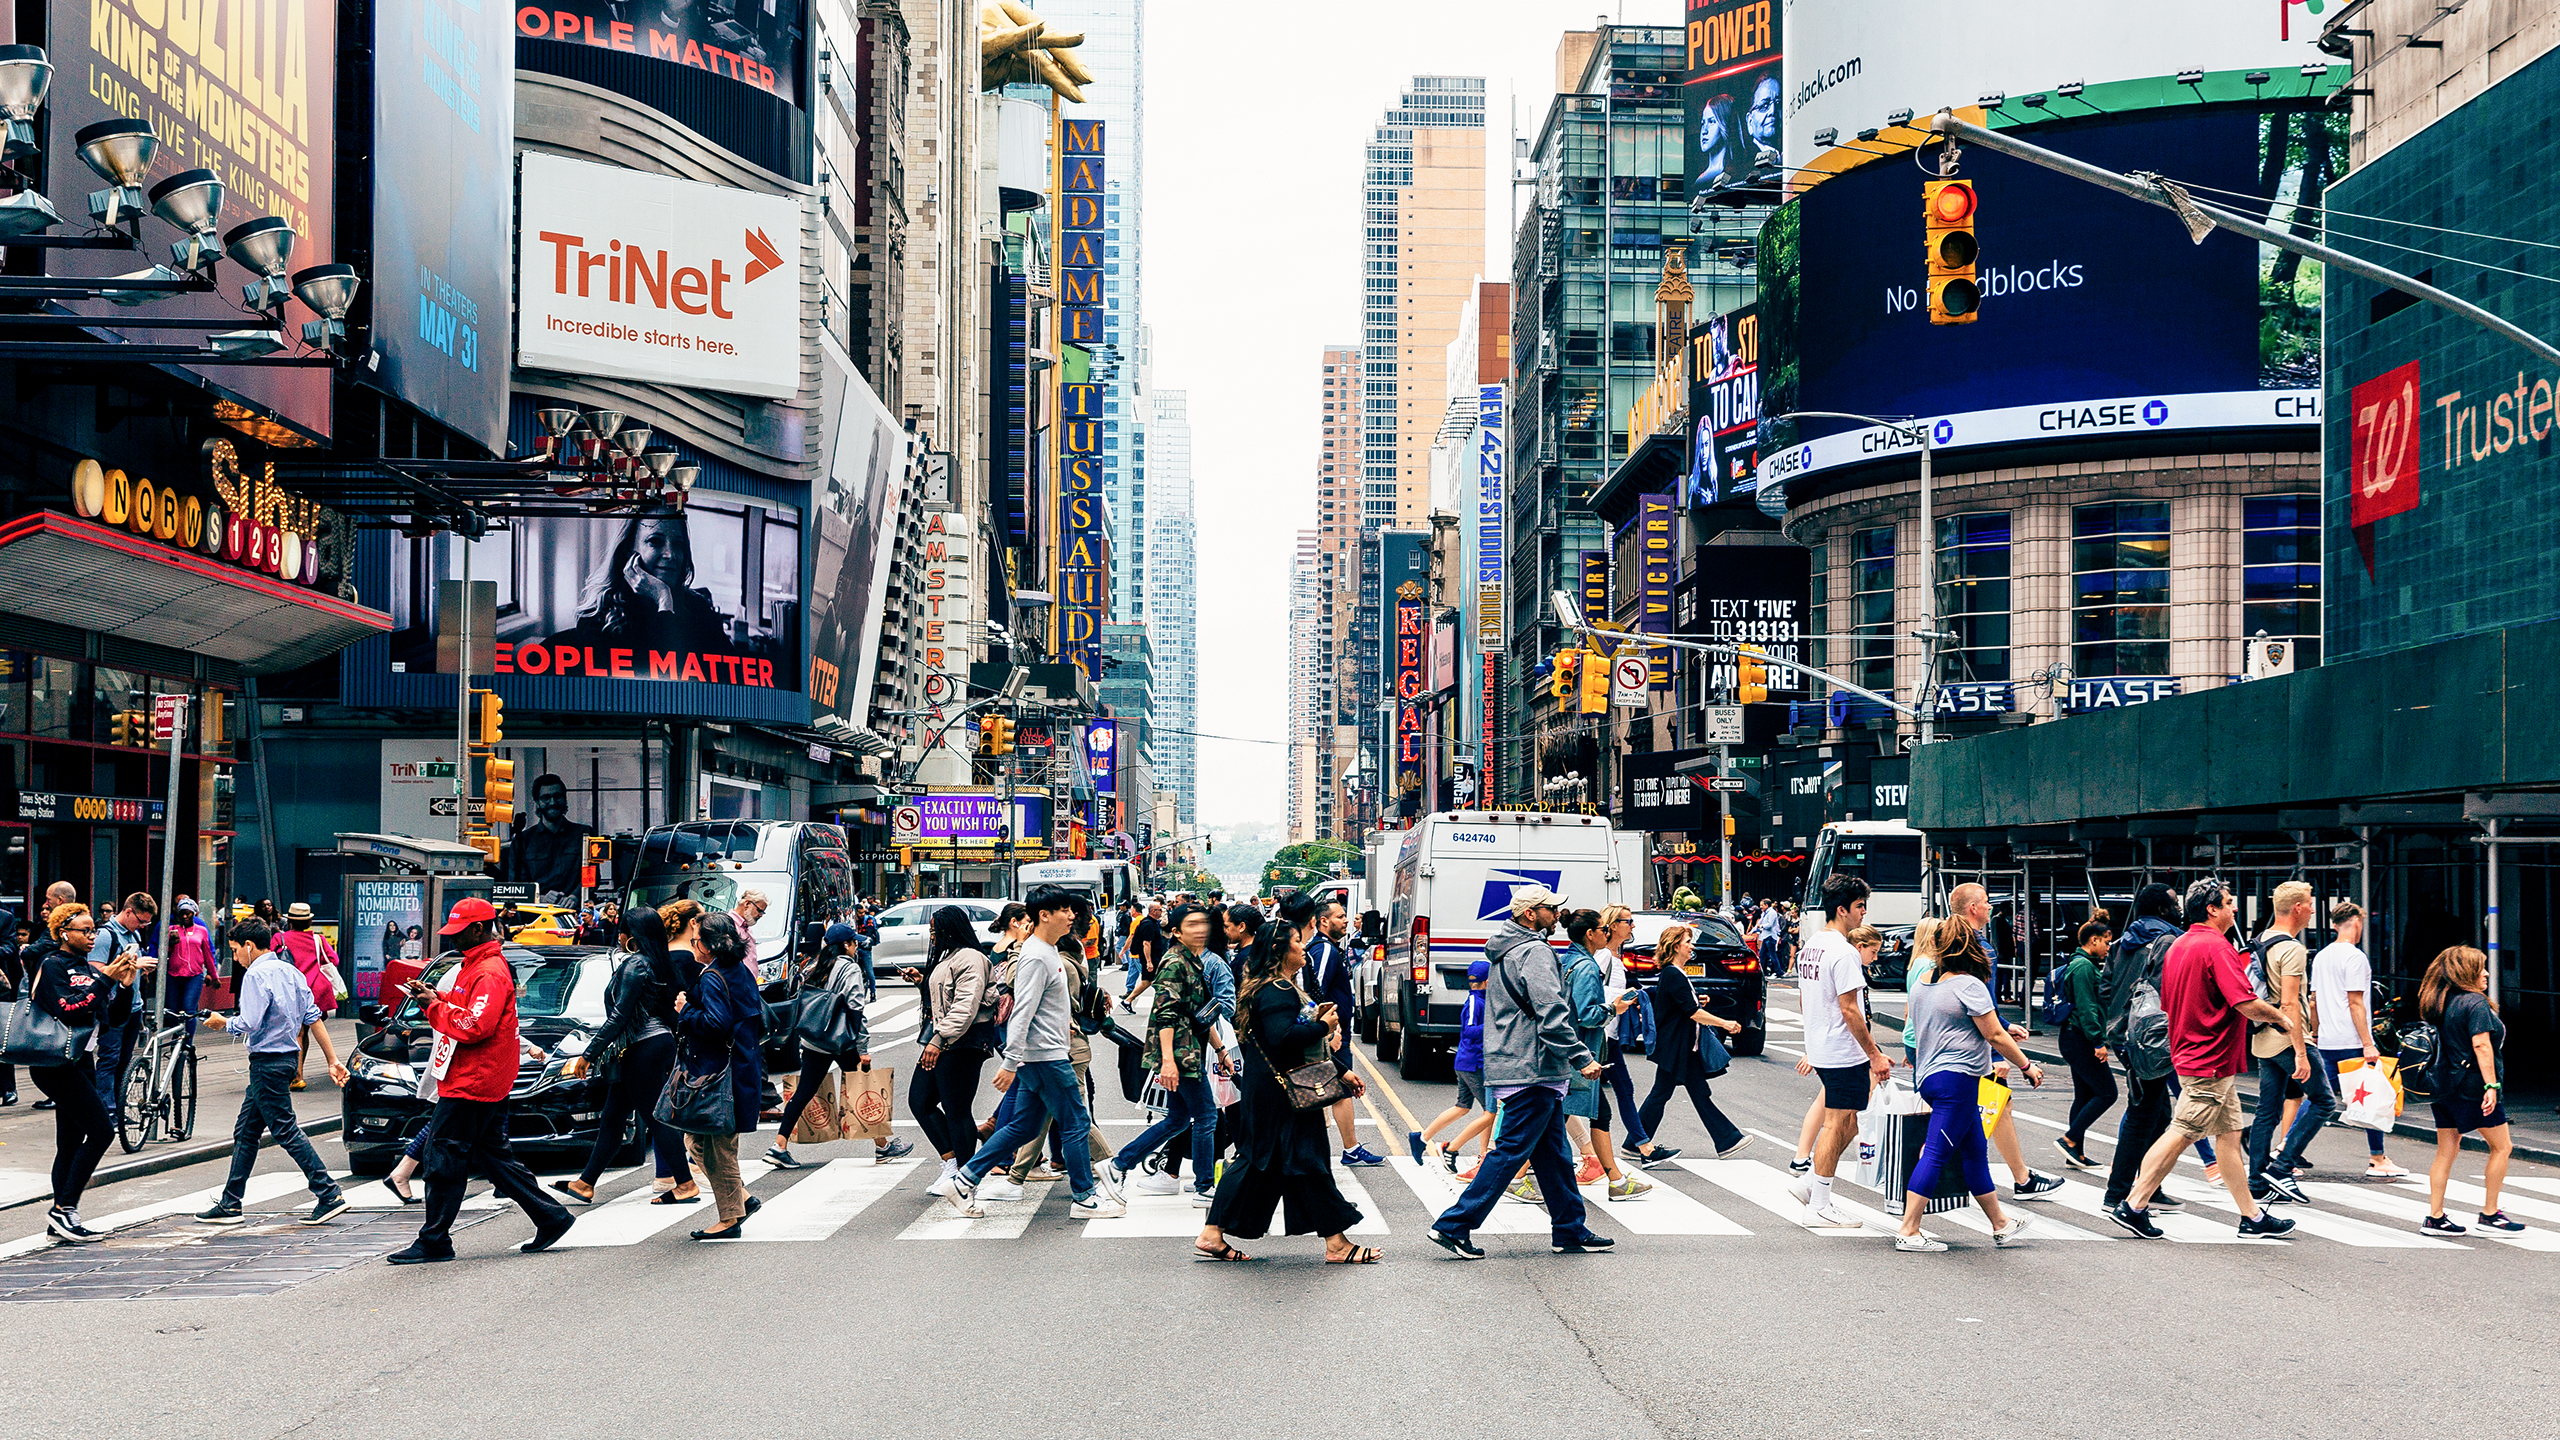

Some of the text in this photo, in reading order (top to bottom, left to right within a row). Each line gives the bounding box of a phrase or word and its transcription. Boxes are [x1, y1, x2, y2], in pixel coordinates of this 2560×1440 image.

[423, 0, 464, 79] KING
[1688, 0, 1771, 71] POWER
[517, 6, 776, 95] OPLE MATTER
[423, 53, 480, 134] MONSTERS
[1797, 55, 1862, 110] slack.com
[90, 0, 309, 204] KING OF THE MONSTERS
[89, 63, 140, 120] LONG
[193, 136, 222, 182] THE
[229, 162, 264, 210] KING
[269, 189, 295, 226] MAY
[297, 210, 309, 241] 31
[1066, 122, 1102, 340] MADAME
[540, 230, 733, 320] TriNet
[420, 264, 478, 325] IN THEATERS
[1886, 286, 1917, 314] No
[420, 293, 478, 373] MAY 31
[547, 314, 739, 356] Incredible starts here.
[1694, 333, 1712, 382] TO
[1480, 386, 1502, 428] NEW
[1711, 384, 1729, 432] TO
[2039, 403, 2136, 431] CHASE
[1862, 425, 1929, 453] CHASE
[1769, 451, 1799, 479] CHASE
[115, 477, 127, 515] N
[140, 486, 151, 523] Q
[164, 492, 175, 530] R
[187, 504, 200, 544] W
[210, 511, 220, 546] S
[251, 529, 260, 560] 2
[270, 536, 279, 566] 3
[309, 547, 317, 577] 7
[1479, 502, 1502, 582] STUDIOS
[1647, 502, 1668, 614] VICTORY
[1480, 591, 1501, 637] DUKE
[1710, 600, 1750, 618] TEXT
[924, 514, 948, 749] AMSTERDAM
[1710, 620, 1799, 642] TO 313131
[495, 643, 775, 689] EOPLE MATTER
[810, 655, 840, 709] ATTER
[1399, 607, 1421, 762] REGAL
[2062, 680, 2174, 708] HASE
[1937, 686, 2006, 713] ASE
[1020, 728, 1043, 737] ALL
[1020, 736, 1045, 745] RISE
[390, 764, 417, 776] TriN
[434, 765, 440, 775] 7
[19, 793, 34, 804] Times
[1453, 765, 1463, 810] DANCE
[1633, 778, 1645, 791] TEXT
[1633, 793, 1640, 807] TO
[1640, 791, 1660, 807] 313131
[1665, 790, 1673, 805] AD
[19, 806, 55, 819] Subway Station
[437, 803, 455, 811] ONE
[1098, 799, 1107, 831] DANCE
[925, 816, 948, 831] YOU
[951, 816, 980, 831] WISH
[370, 842, 401, 856] Phone
[1453, 832, 1496, 844] 6424740
[860, 853, 900, 861] SEPHOR
[358, 882, 418, 897] NEVER BEEN
[358, 896, 421, 912] NOMINATED.
[357, 912, 386, 927] EVER.
[471, 993, 489, 1018] TOP
[436, 1038, 450, 1062] 29
[861, 1102, 883, 1115] TRADER
